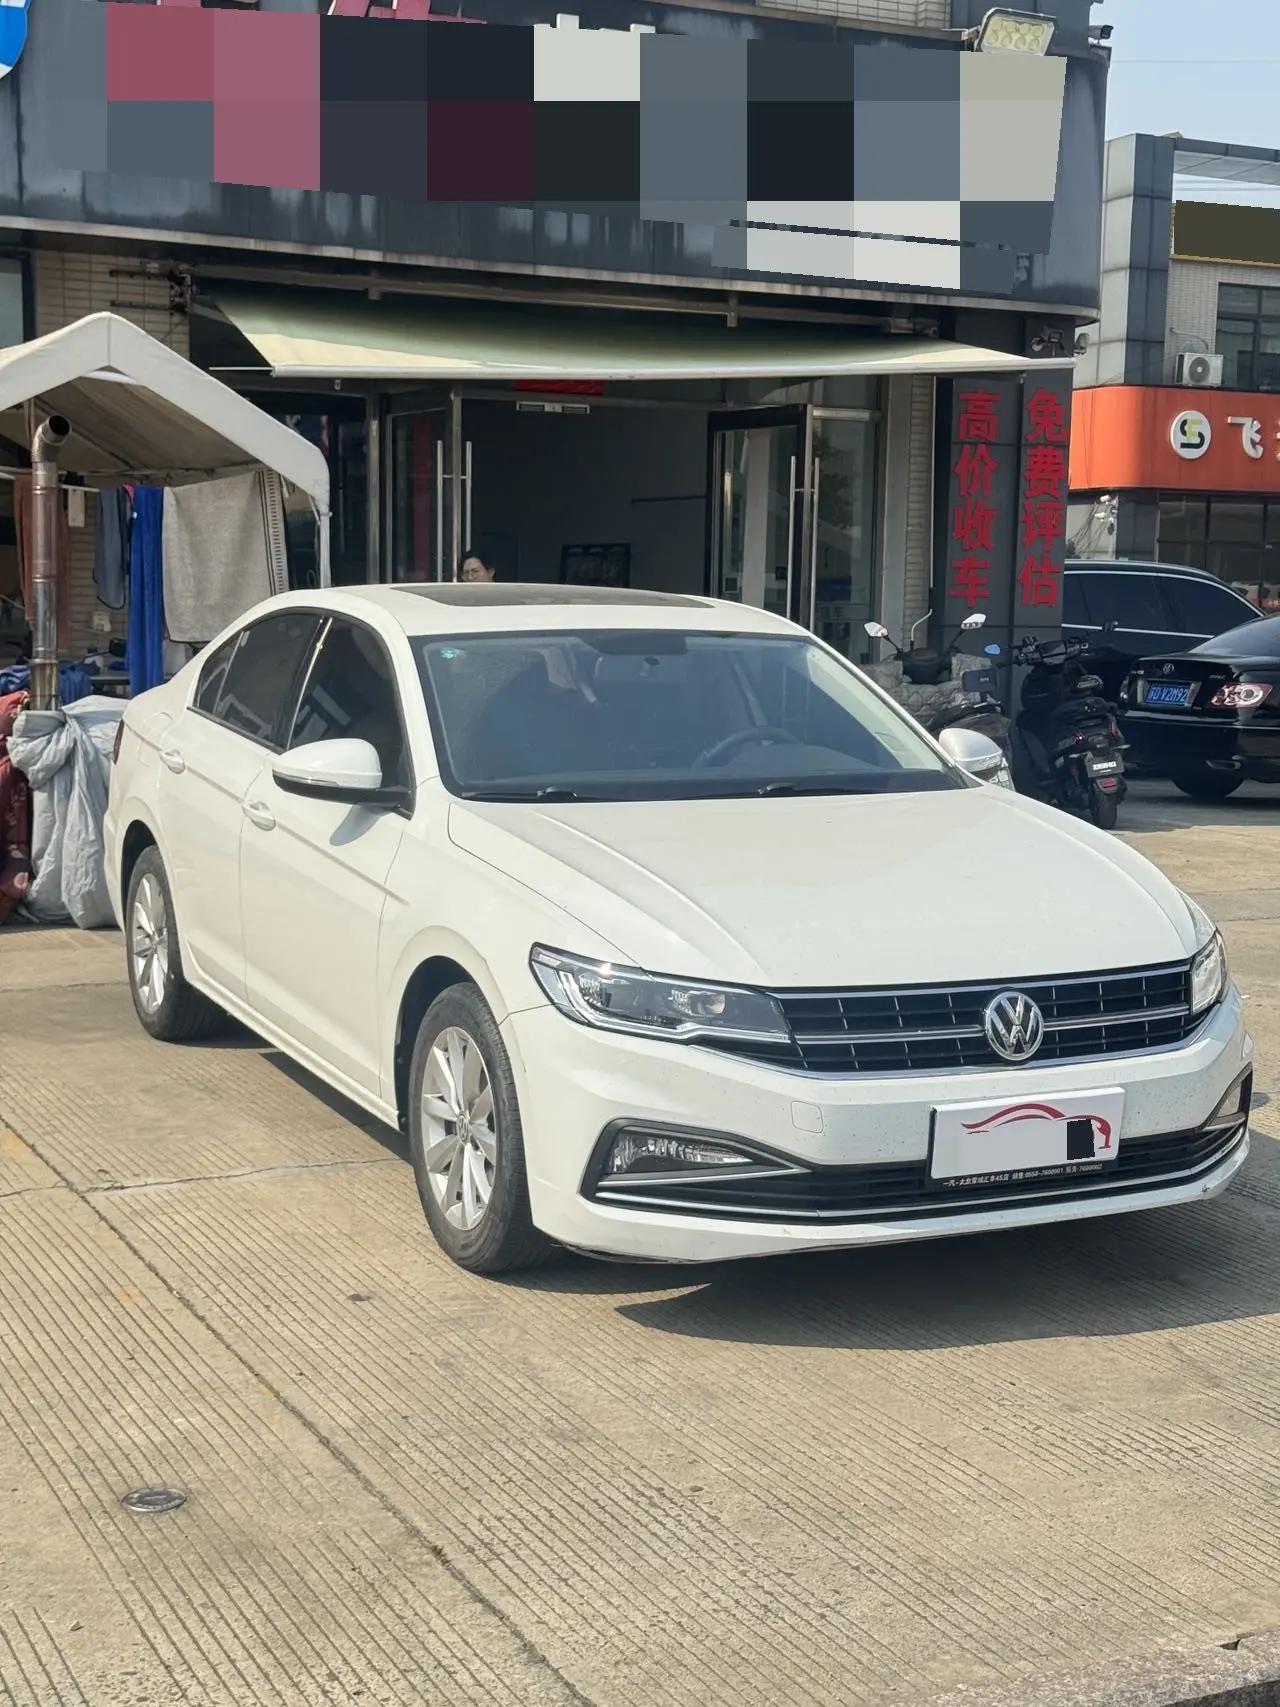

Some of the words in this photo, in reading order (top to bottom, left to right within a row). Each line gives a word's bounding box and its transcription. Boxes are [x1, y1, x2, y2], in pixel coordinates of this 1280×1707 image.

[950, 389, 1000, 608] 高价收车
[1018, 387, 1068, 608] 免费评估
[1227, 416, 1280, 461] 飞
